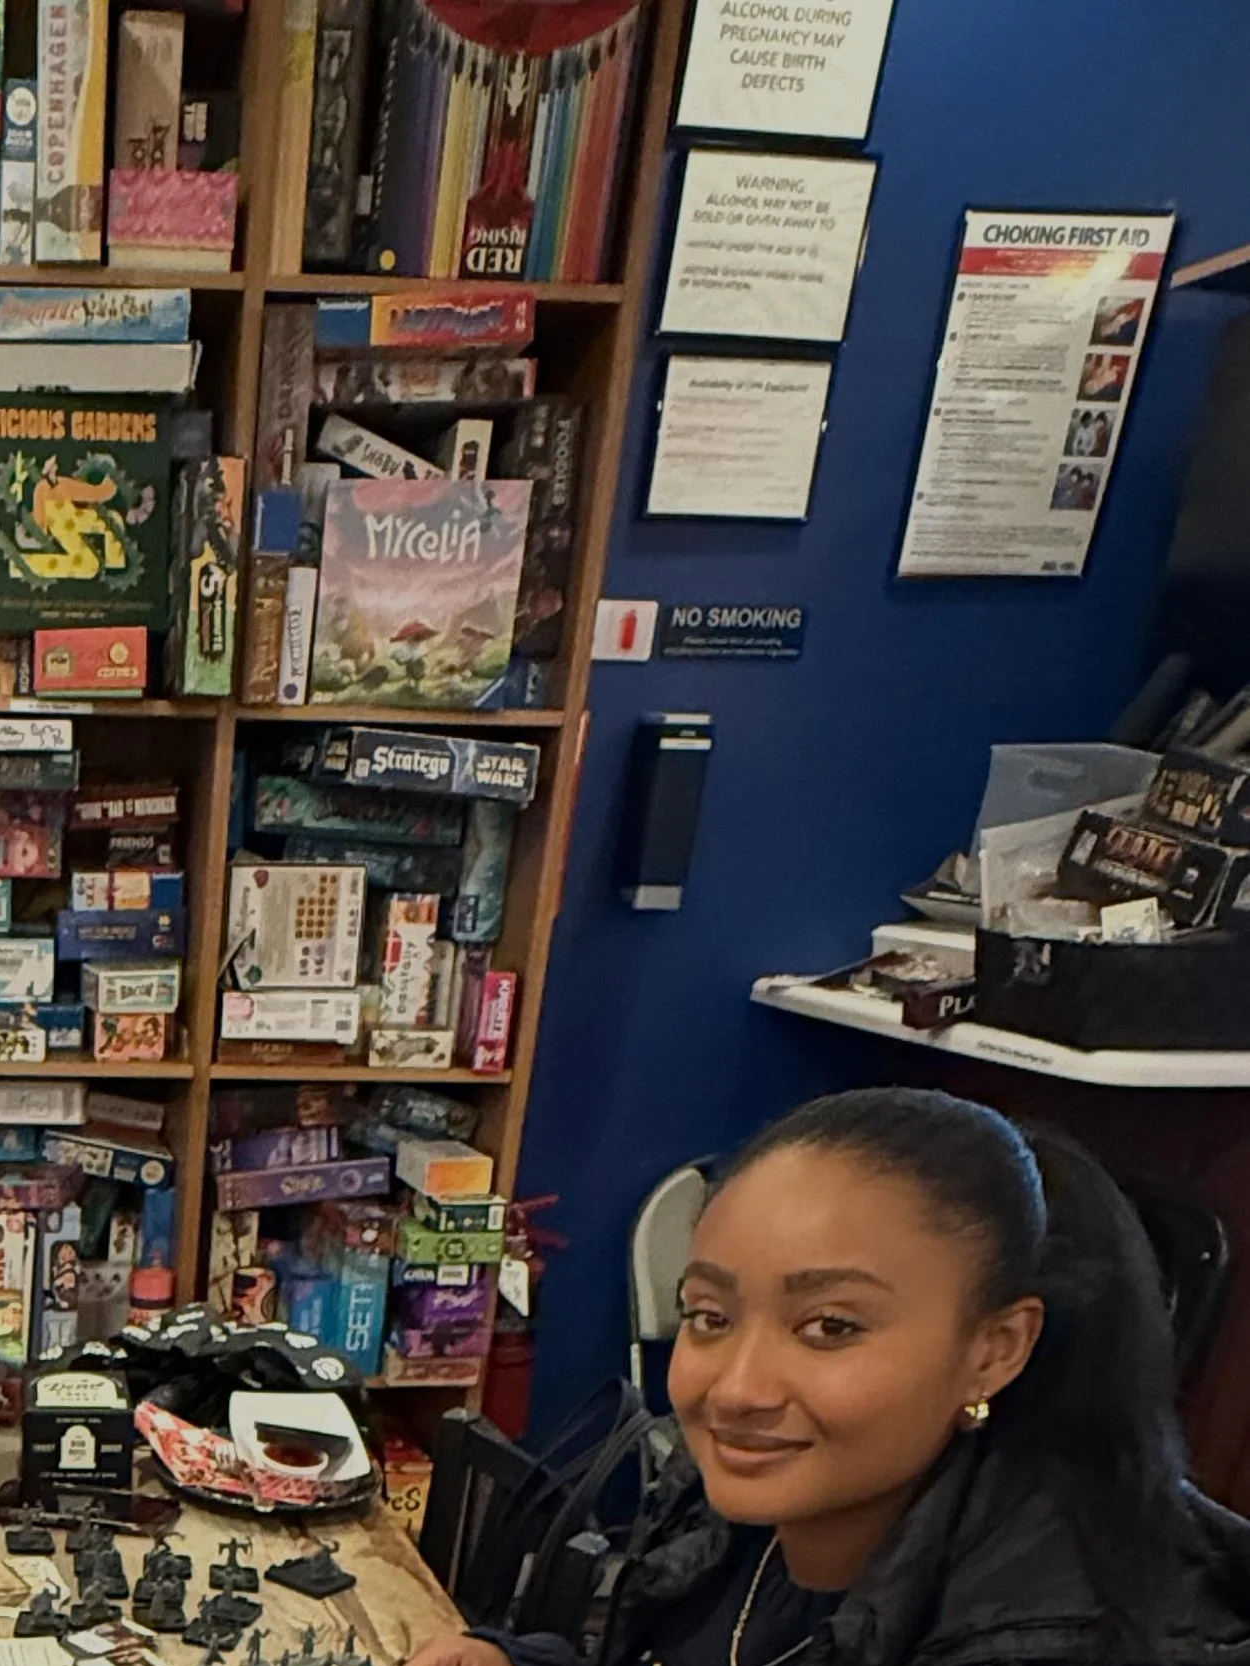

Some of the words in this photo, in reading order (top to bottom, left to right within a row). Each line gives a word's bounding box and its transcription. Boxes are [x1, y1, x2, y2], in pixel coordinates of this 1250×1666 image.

[720, 2, 790, 22] ALCOHOL
[794, 9, 852, 26] DURING
[720, 23, 809, 46] PREGNANCY
[813, 33, 846, 48] MAY
[730, 48, 777, 67] CAUSE
[782, 52, 826, 71] BIRTH
[49, 0, 67, 184] COPENHAGEN
[741, 72, 805, 93] DEFECTS
[736, 175, 806, 194] WARNING
[705, 193, 759, 209] ALCOHOL
[470, 226, 527, 247] RISING
[982, 224, 1065, 246] CHOKING
[1067, 226, 1116, 247] FIRST
[1117, 227, 1150, 248] AID
[466, 248, 523, 274] RED
[70, 410, 157, 443] GARDENS
[671, 607, 702, 627] NO
[707, 608, 802, 628] SMOKING
[370, 747, 452, 781] Stratego
[476, 754, 528, 773] STAR
[476, 769, 528, 787] WARS
